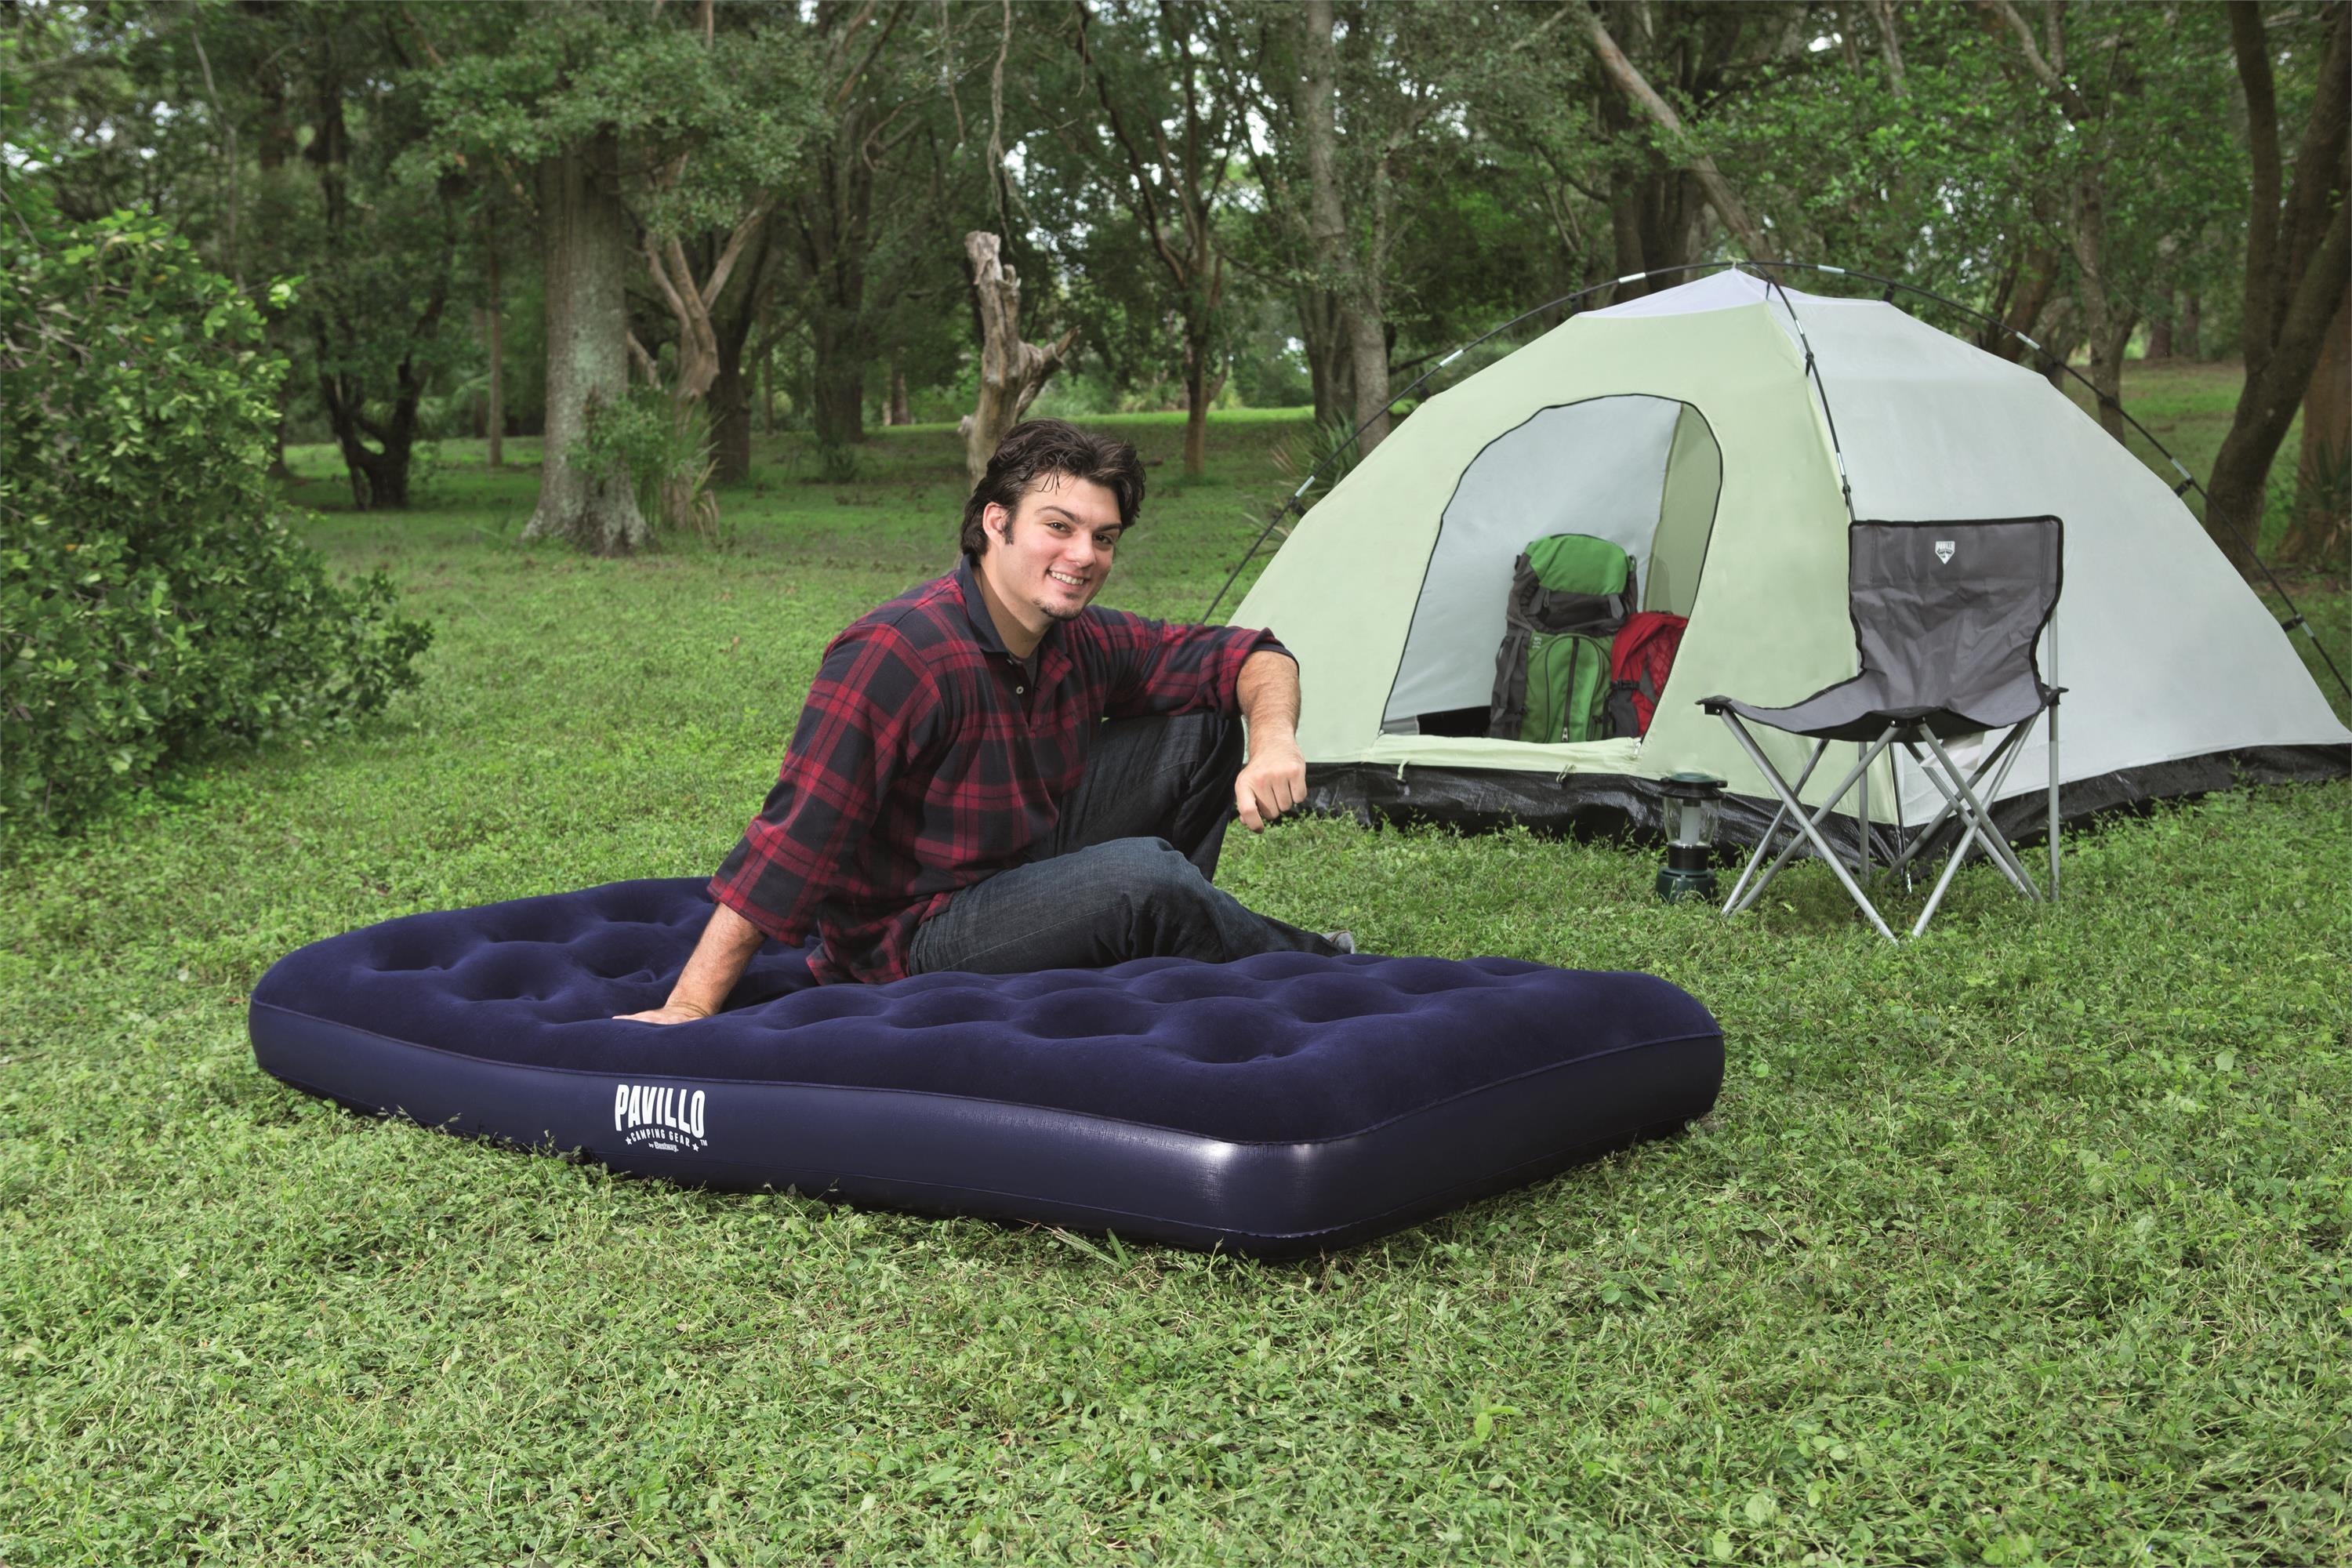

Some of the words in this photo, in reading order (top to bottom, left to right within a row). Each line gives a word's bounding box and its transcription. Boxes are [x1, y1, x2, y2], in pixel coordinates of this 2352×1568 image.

[615, 1084, 706, 1138] PAVILLO
[630, 1128, 666, 1142] CAMPING
[669, 1131, 690, 1147] GEAR
